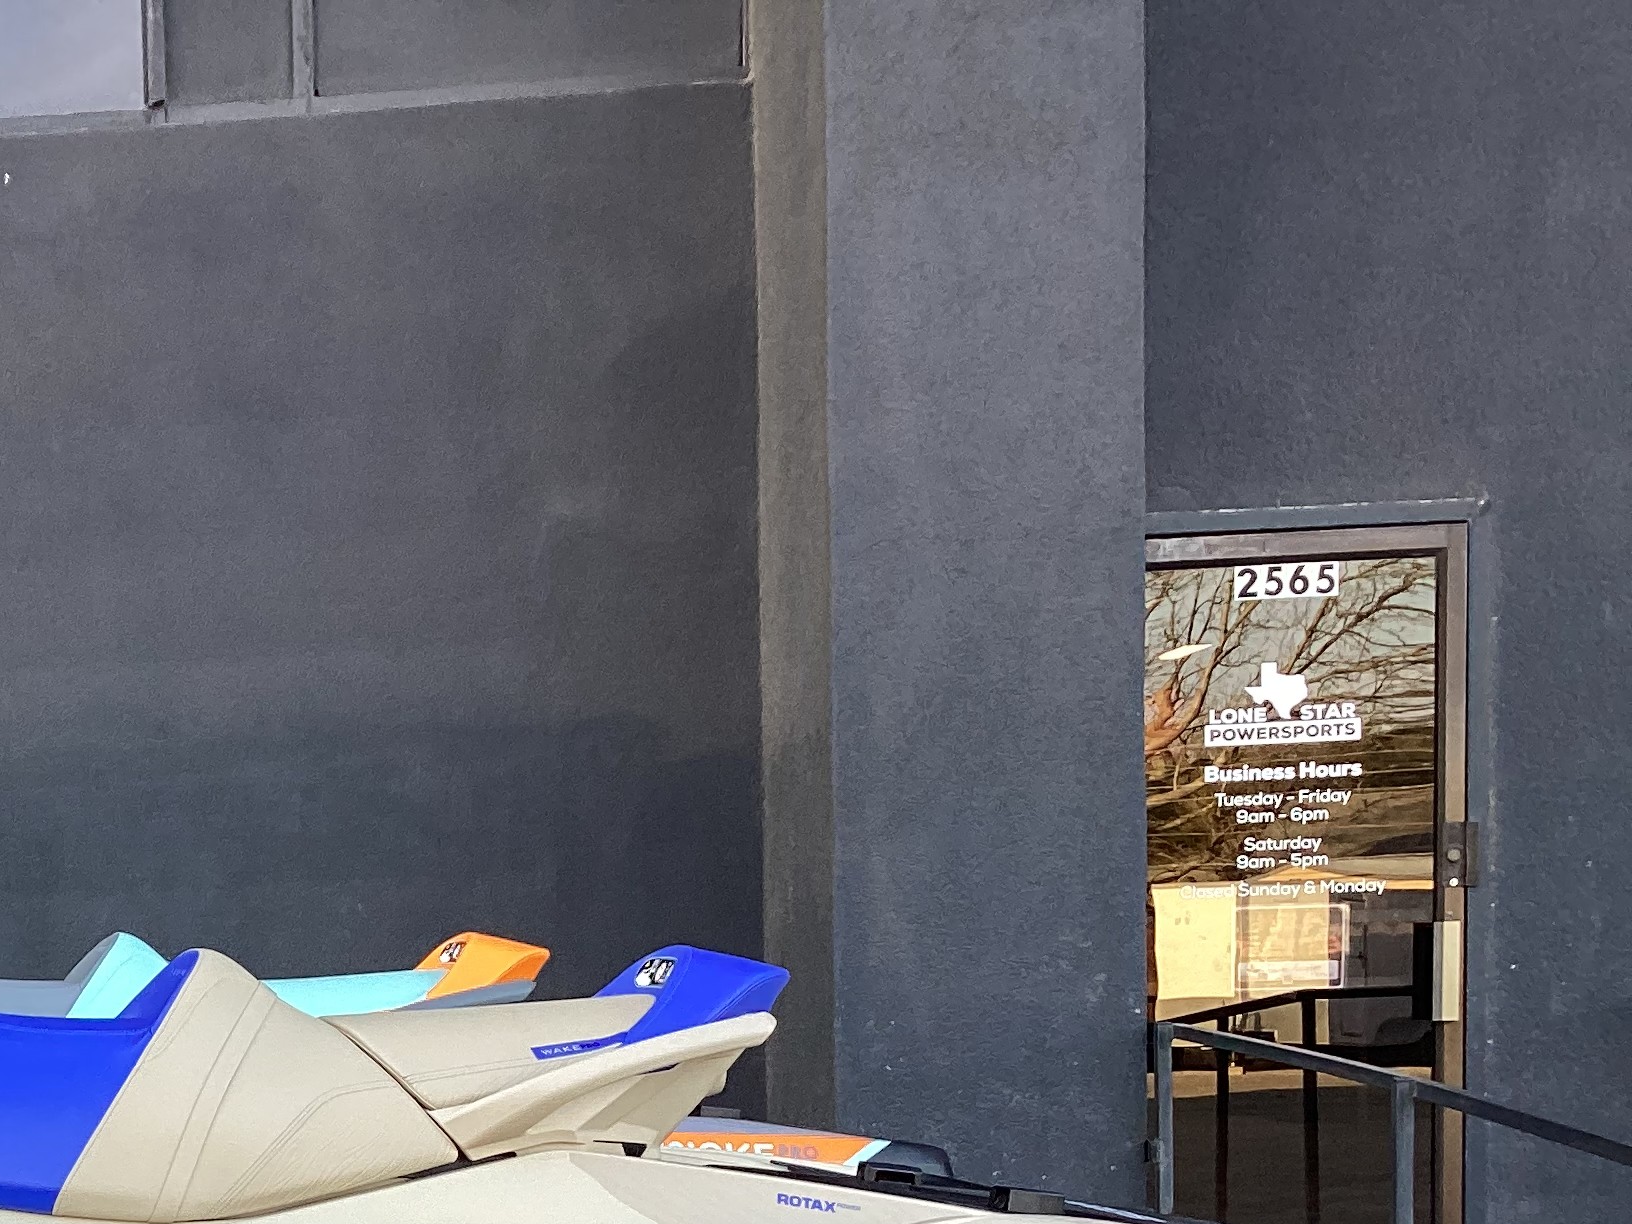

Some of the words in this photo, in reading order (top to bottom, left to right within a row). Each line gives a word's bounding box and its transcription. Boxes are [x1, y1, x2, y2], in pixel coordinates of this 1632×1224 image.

[1237, 564, 1335, 598] 2565
[1209, 707, 1268, 724] LONE
[1299, 702, 1356, 720] STAR
[1209, 722, 1357, 743] POWERSPORTS
[1204, 764, 1296, 783] Business
[1299, 760, 1363, 780] Hours
[1215, 791, 1284, 808] Tuesday
[1298, 788, 1352, 806] Friday
[1236, 809, 1275, 825] 9am
[1290, 806, 1330, 825] 6pm
[1243, 836, 1322, 853] Saturday
[1236, 854, 1276, 870] 9am
[1290, 852, 1329, 870] 5pm
[1238, 881, 1301, 900] Sunday
[1303, 880, 1317, 895] &
[1319, 877, 1387, 895] Monday
[777, 1193, 836, 1213] ROTAX
